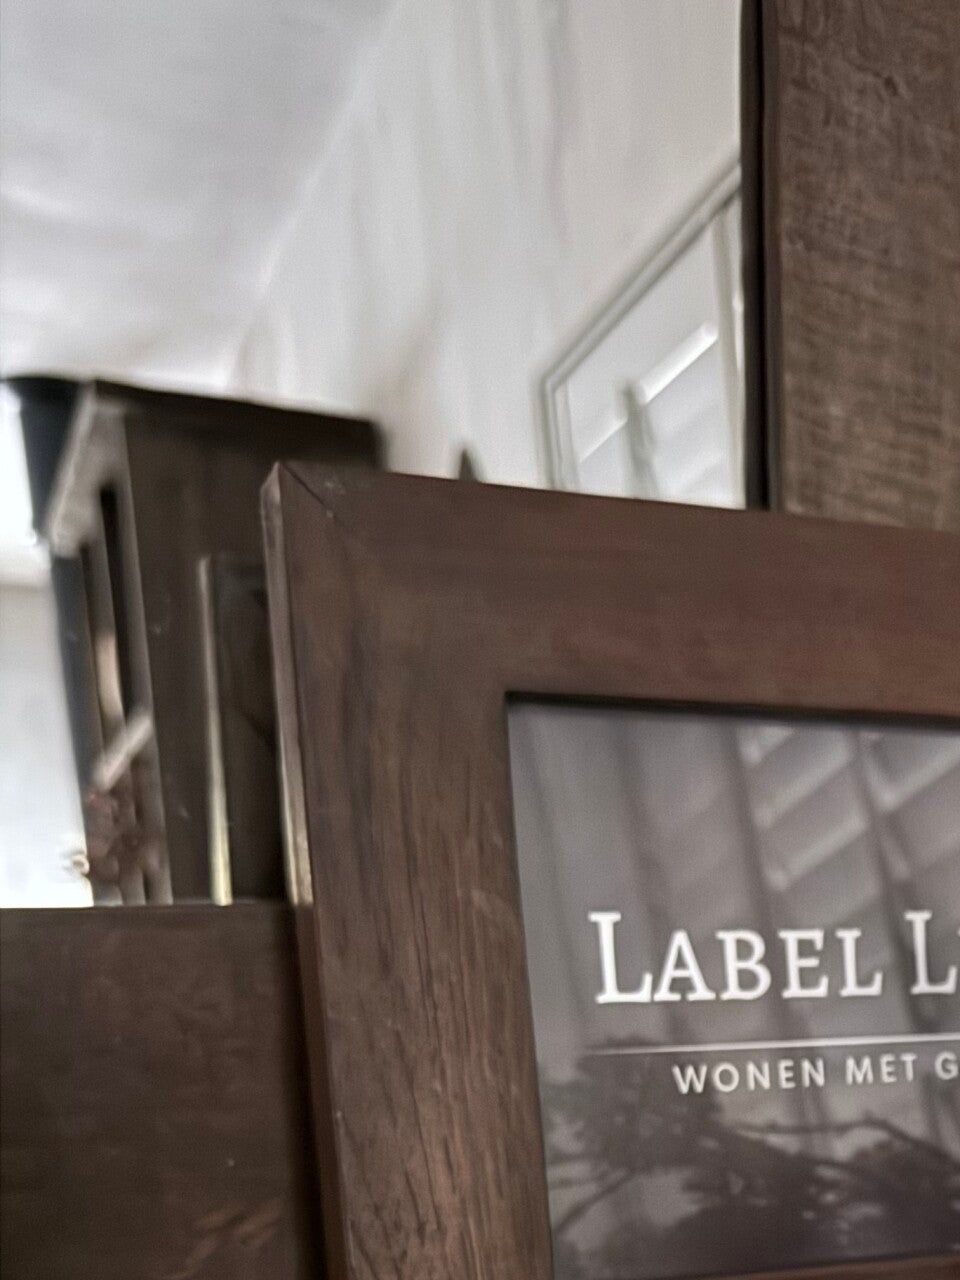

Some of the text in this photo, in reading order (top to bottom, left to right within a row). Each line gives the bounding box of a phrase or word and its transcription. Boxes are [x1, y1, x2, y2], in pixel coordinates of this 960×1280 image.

[588, 911, 883, 1004] LABEL
[672, 1059, 826, 1094] WONEN
[845, 1053, 918, 1086] MET
